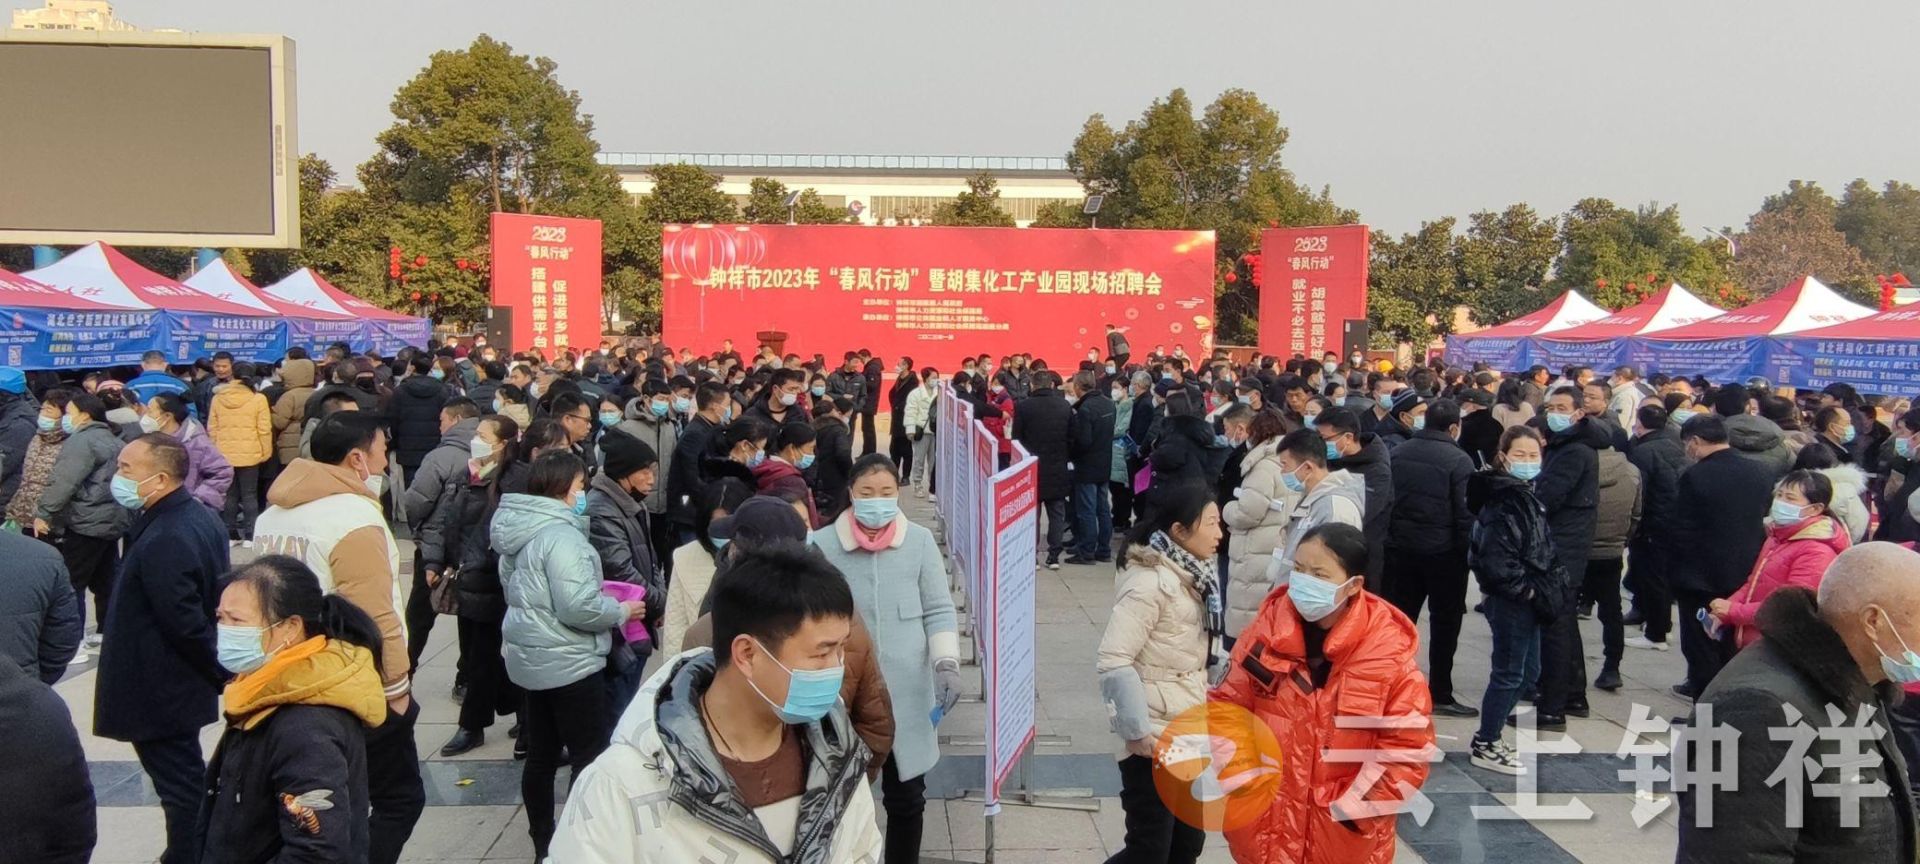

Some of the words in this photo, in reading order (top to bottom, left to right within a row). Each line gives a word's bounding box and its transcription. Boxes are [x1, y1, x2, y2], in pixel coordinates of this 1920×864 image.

[531, 267, 548, 348] 搭建供需平台
[552, 279, 568, 352] 促进返乡就
[709, 265, 1163, 296] 钟祥市2023年“春风行动”暨胡集化工产业园现场招聘会
[1291, 278, 1306, 356] 就业不必去远
